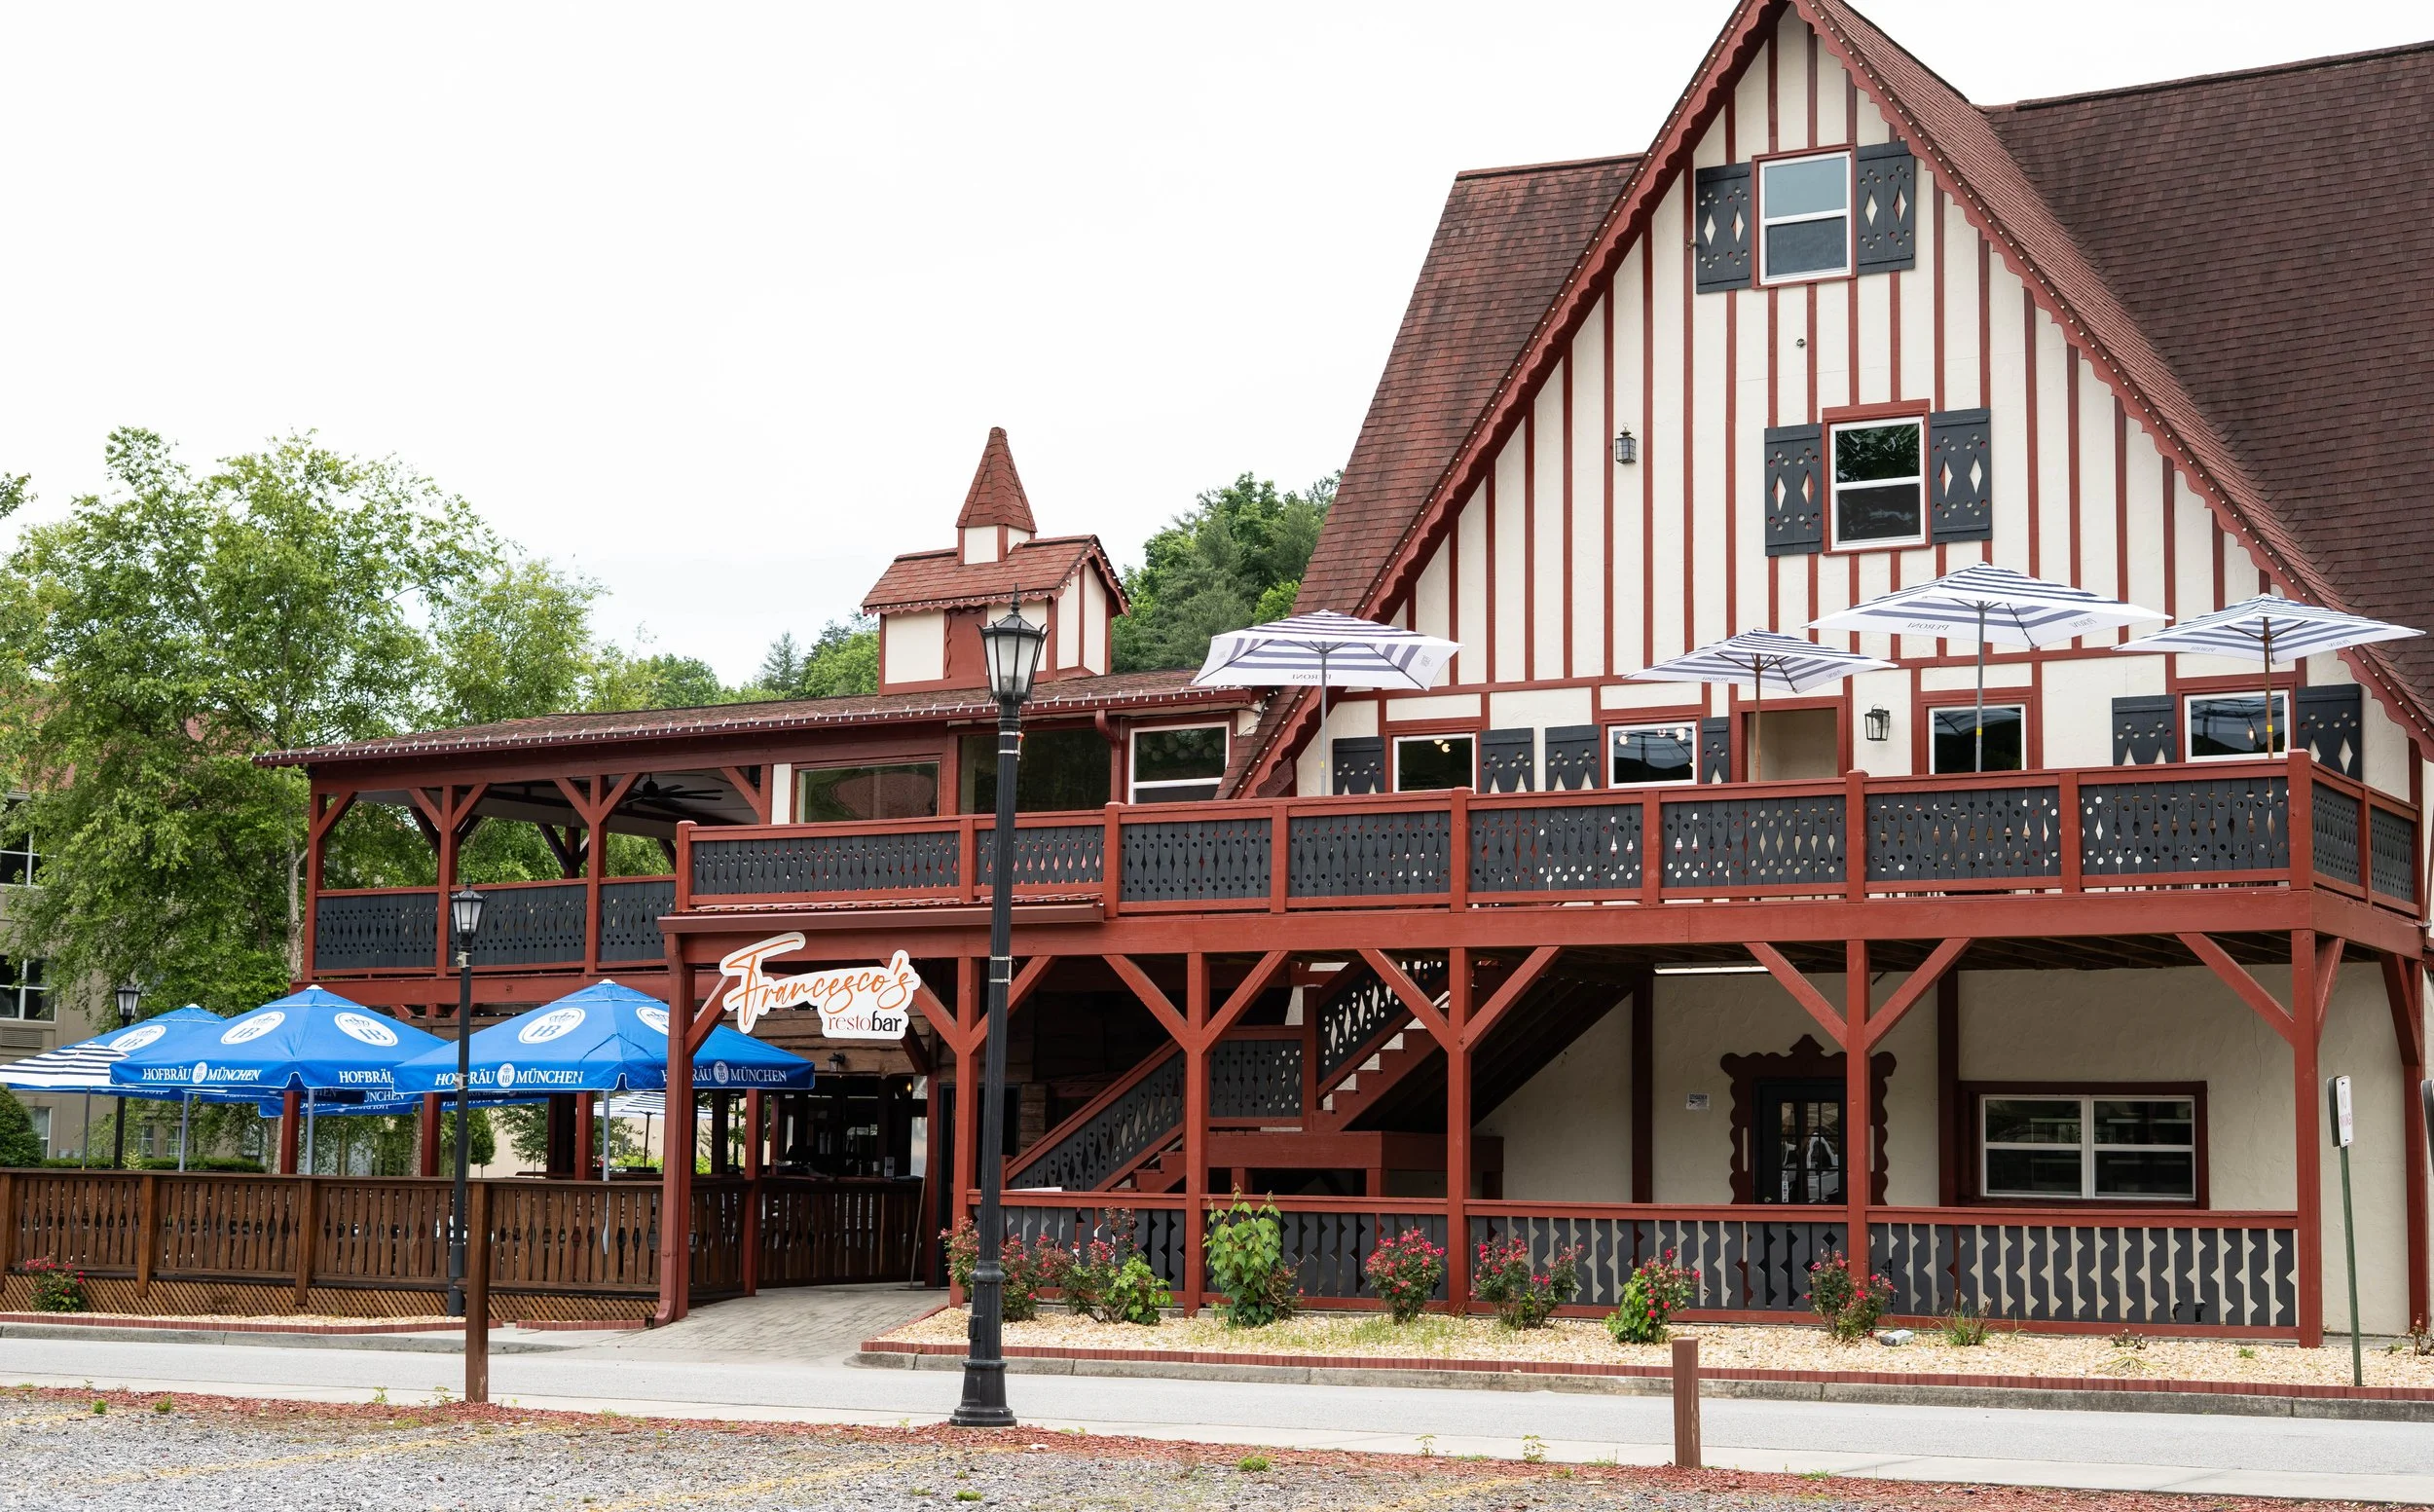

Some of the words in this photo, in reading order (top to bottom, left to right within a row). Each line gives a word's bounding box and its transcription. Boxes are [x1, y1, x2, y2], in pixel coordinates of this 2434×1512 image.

[725, 939, 914, 1026] Francesco's
[828, 1010, 903, 1032] restobar
[142, 1065, 192, 1082] HOFBRÄU
[205, 1066, 263, 1082] MÜNCHEN
[434, 1068, 496, 1086] HORÄU
[515, 1068, 584, 1085] MÜNCHEN
[660, 1065, 712, 1083] HRÄU
[730, 1066, 788, 1083] MÜNCHEN
